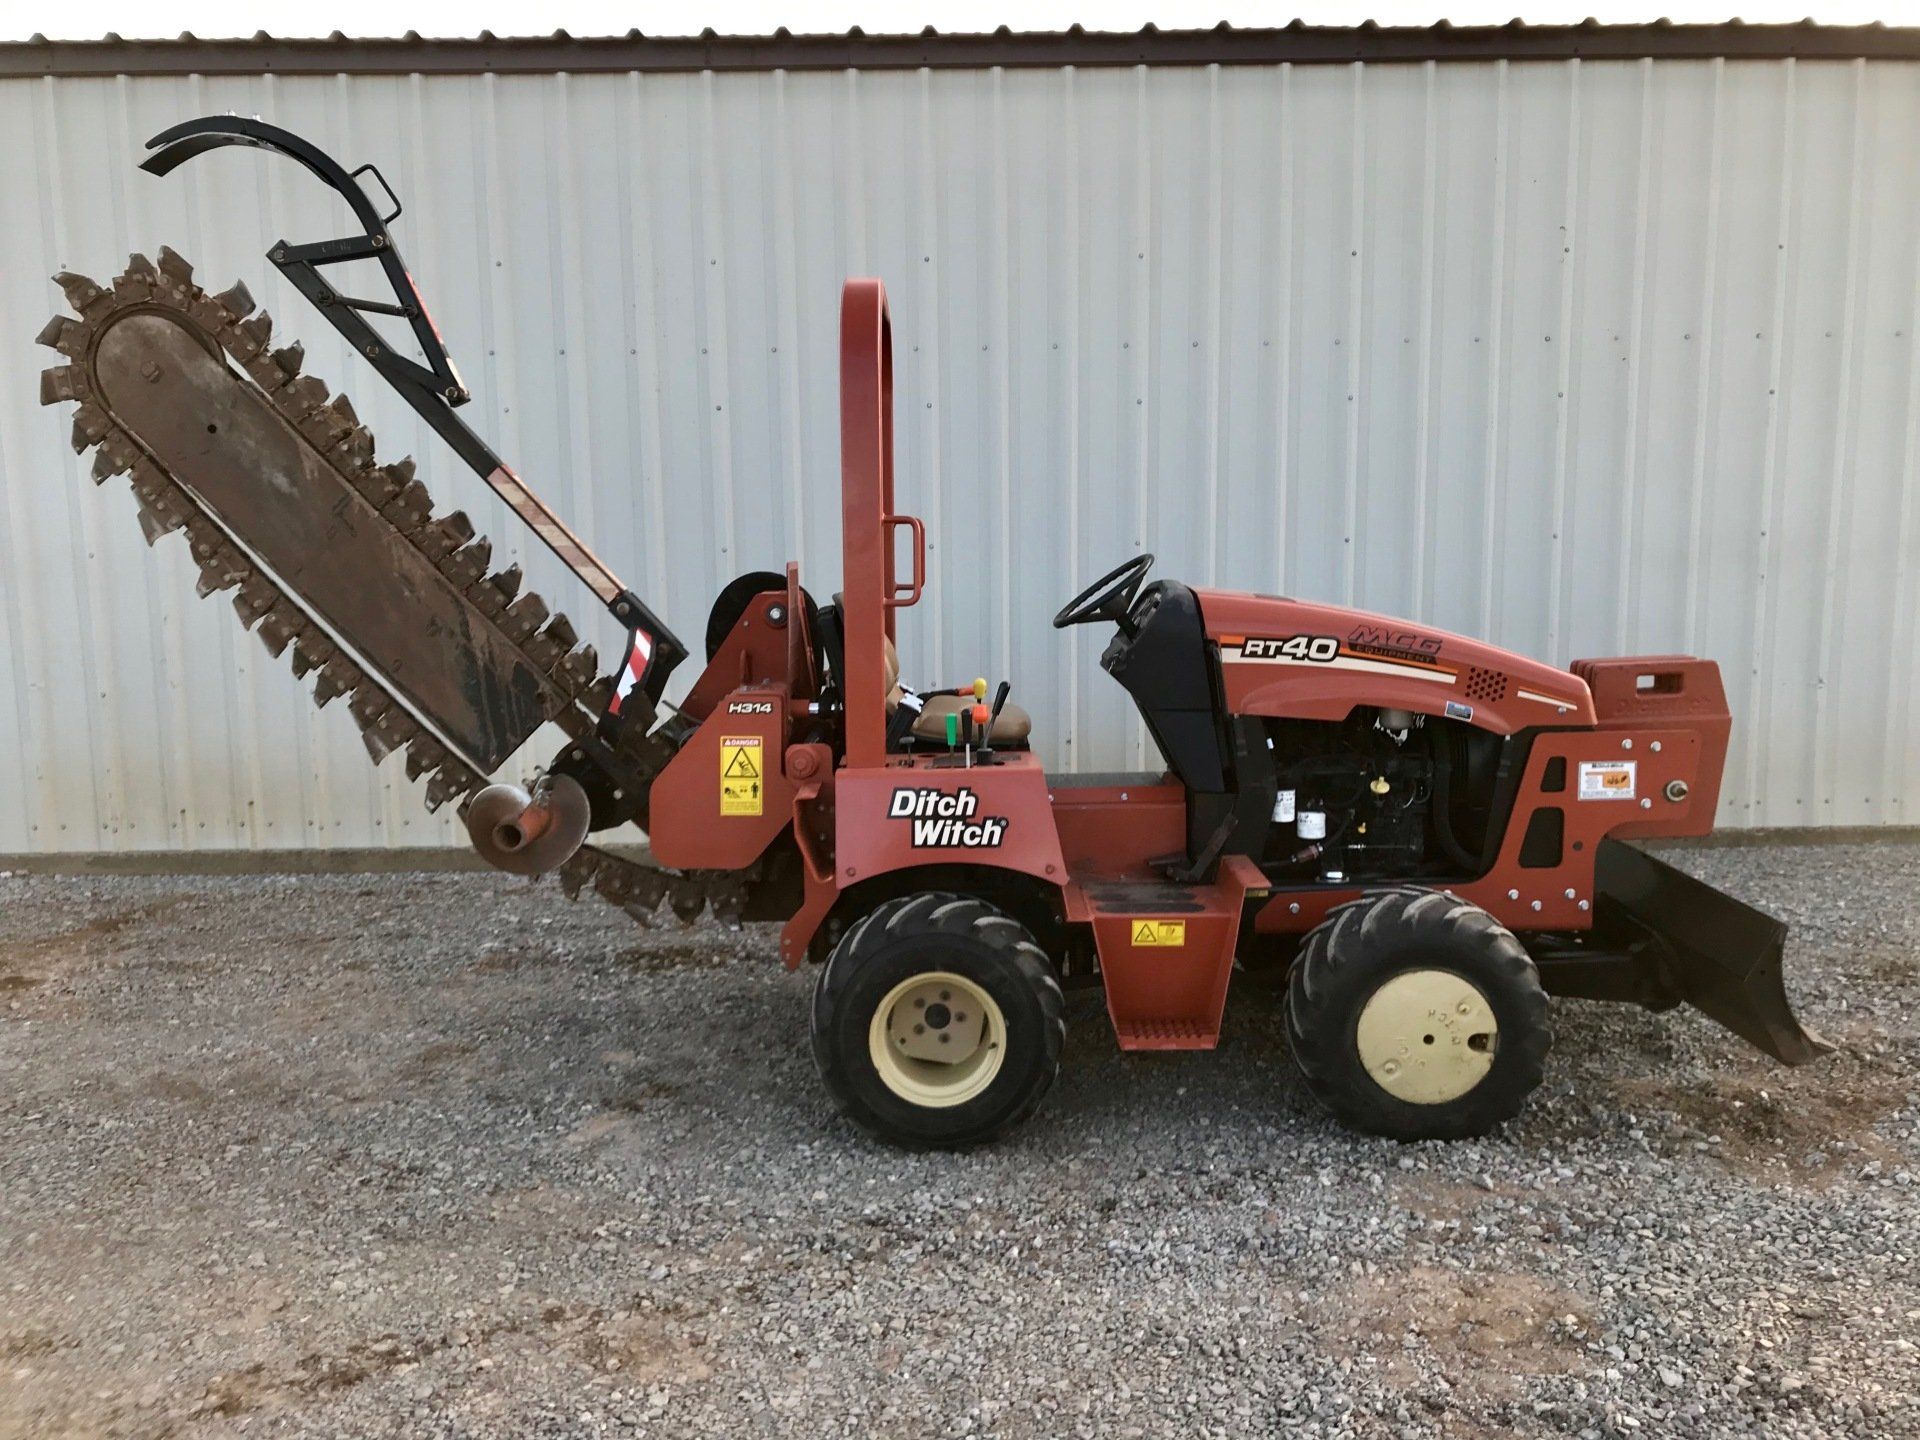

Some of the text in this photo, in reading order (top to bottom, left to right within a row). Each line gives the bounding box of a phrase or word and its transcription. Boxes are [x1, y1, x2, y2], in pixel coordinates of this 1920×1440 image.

[1243, 636, 1339, 661] RT40
[1348, 625, 1443, 655] MCG
[1355, 645, 1433, 664] EQUIPMENT
[728, 703, 772, 714] H314
[890, 789, 977, 817] Ditch
